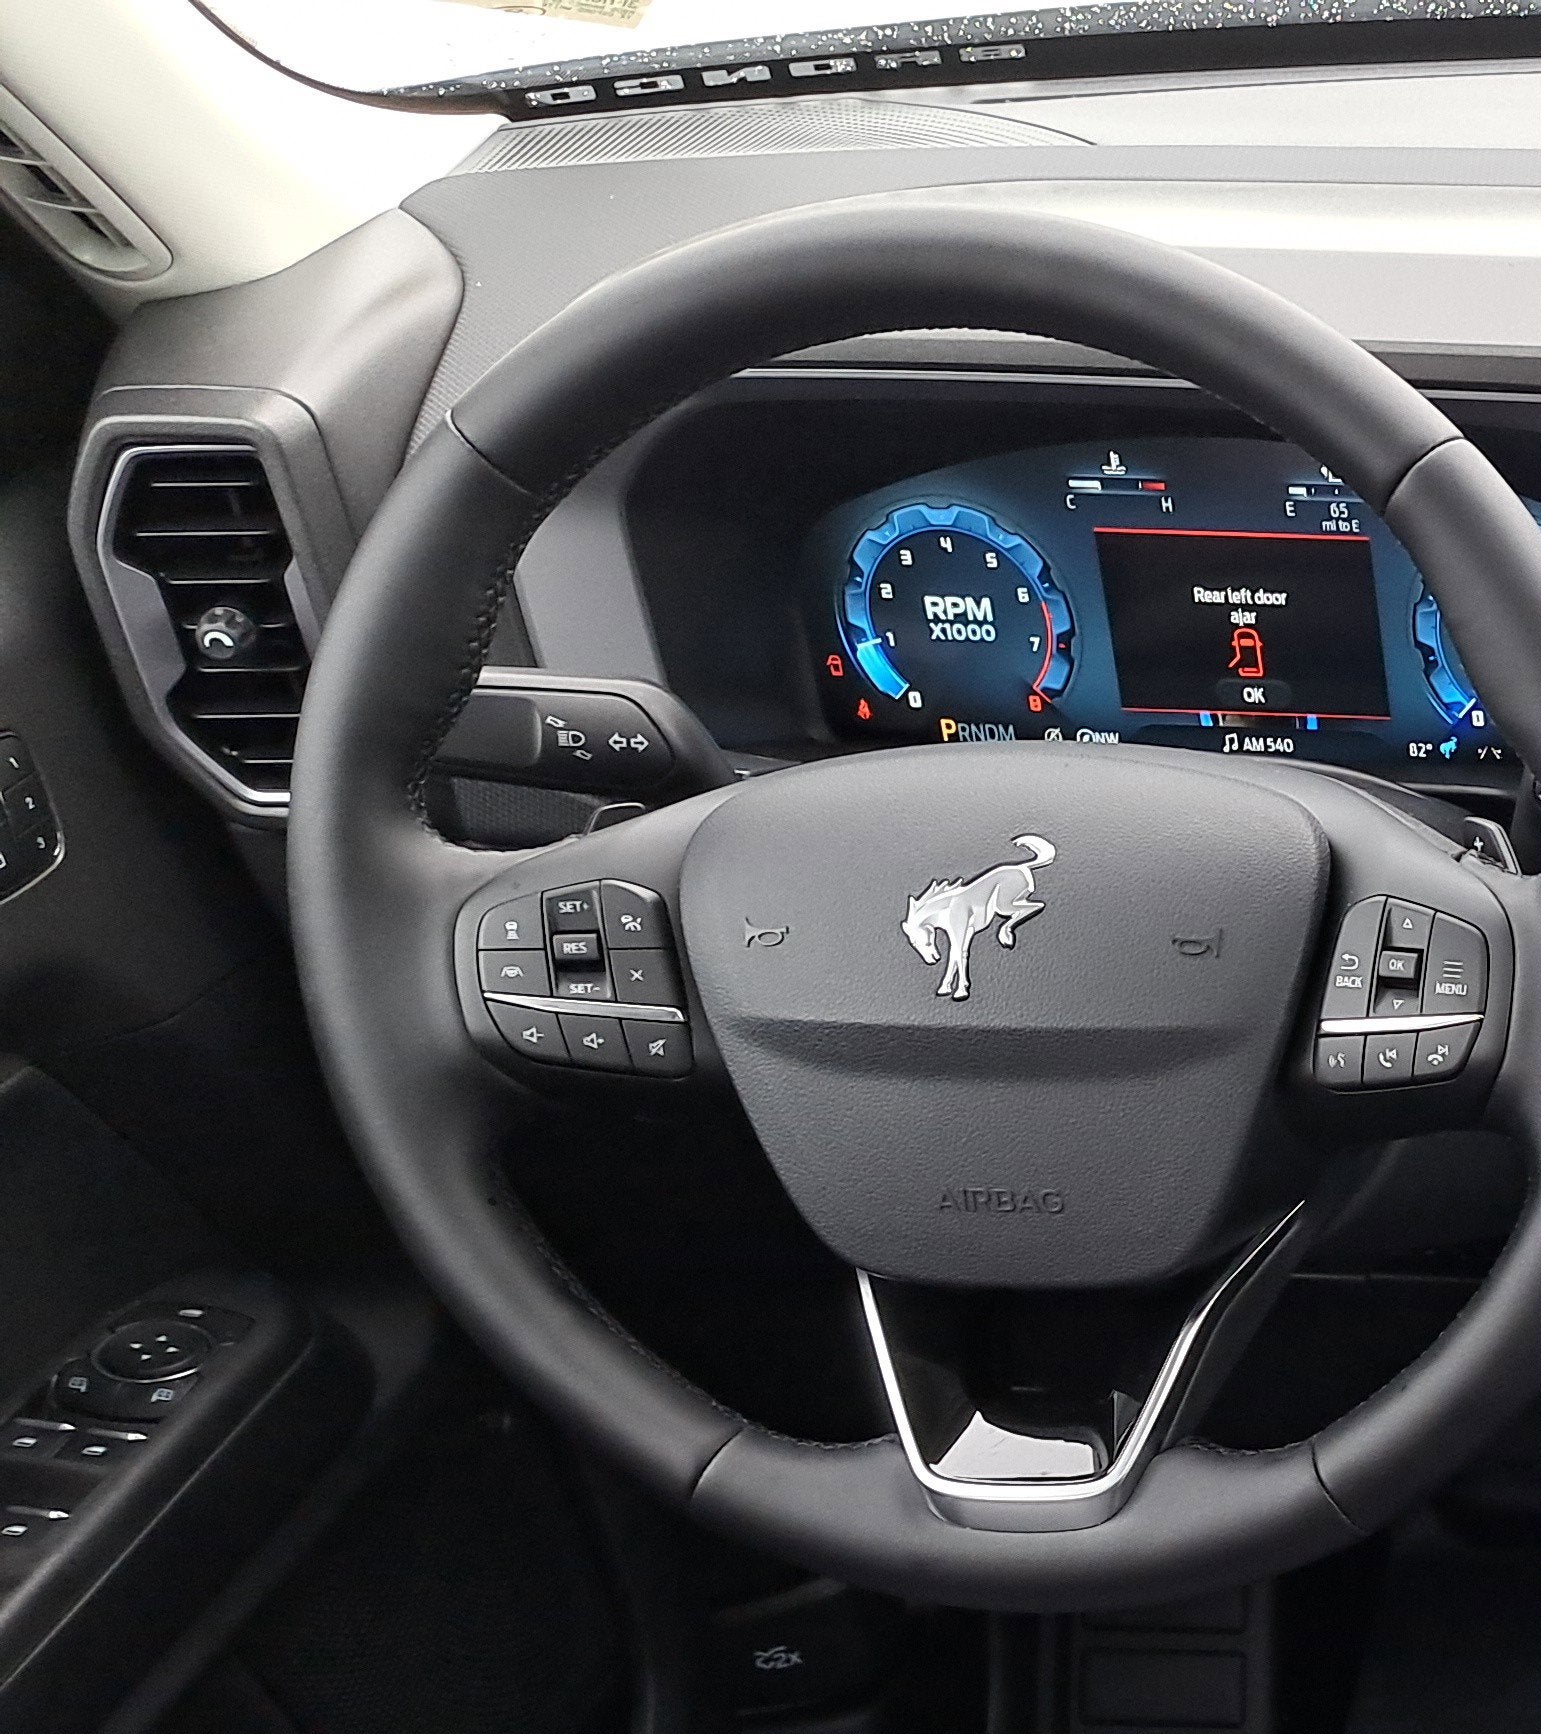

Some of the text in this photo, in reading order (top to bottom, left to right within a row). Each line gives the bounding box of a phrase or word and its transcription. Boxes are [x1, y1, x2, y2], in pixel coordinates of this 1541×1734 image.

[1066, 495, 1077, 509] C
[1161, 497, 1175, 513] H
[1285, 501, 1296, 517] E
[1322, 519, 1360, 532] mi to E
[939, 537, 953, 552] 4
[900, 550, 912, 565] 3
[985, 553, 998, 568] 5
[880, 583, 893, 599] 2
[1017, 588, 1029, 602] 6
[1193, 586, 1287, 605] Rear left door
[924, 596, 993, 622] RPM
[1230, 607, 1256, 626] ajar
[885, 632, 895, 646] 1
[930, 623, 996, 641] X1000
[1030, 637, 1040, 652] 7
[908, 691, 922, 708] 0
[1243, 686, 1266, 704] OK
[1243, 736, 1294, 753] AM 540
[563, 942, 587, 954] RES
[1389, 959, 1405, 971] OK
[1336, 976, 1363, 988] BACK
[1434, 982, 1467, 996] MENU
[939, 1188, 1065, 1215] AIRBAG
